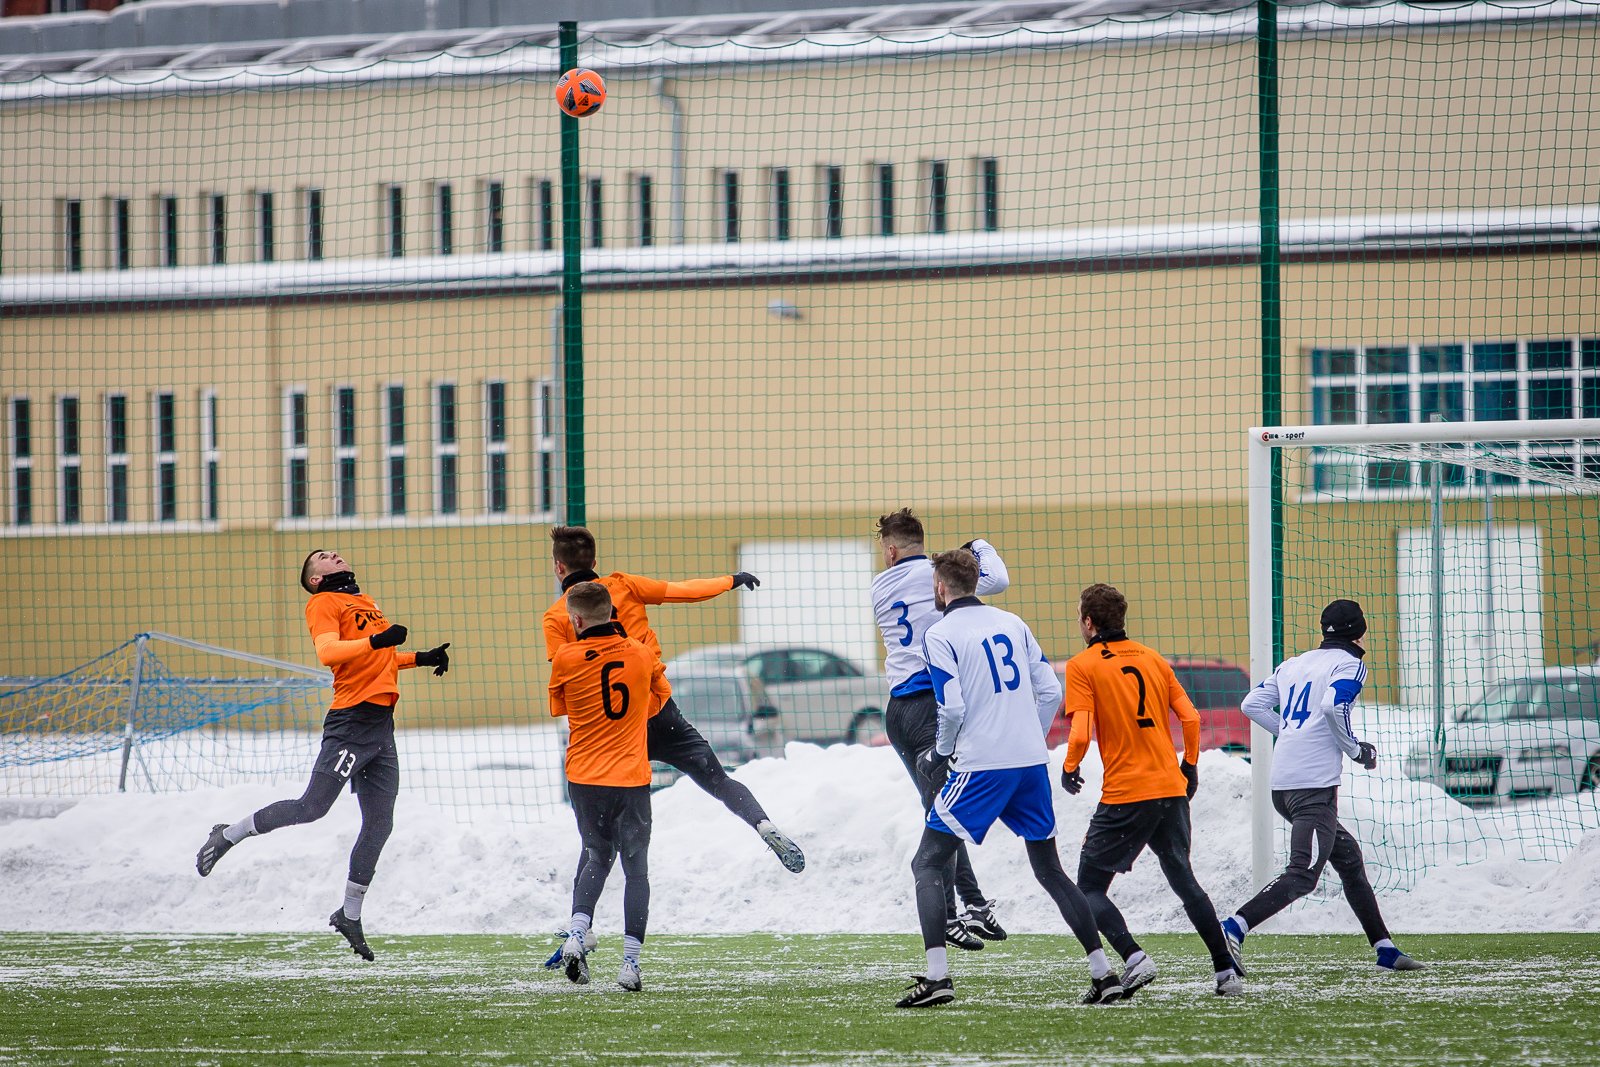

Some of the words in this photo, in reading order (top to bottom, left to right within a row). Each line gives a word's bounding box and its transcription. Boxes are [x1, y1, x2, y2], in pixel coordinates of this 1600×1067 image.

[1285, 431, 1305, 440] sport
[890, 600, 913, 647] 3
[981, 633, 1021, 694] 13
[601, 660, 630, 721] 6
[1120, 665, 1156, 729] 2
[1281, 680, 1312, 730] 14
[333, 748, 357, 778] 13
